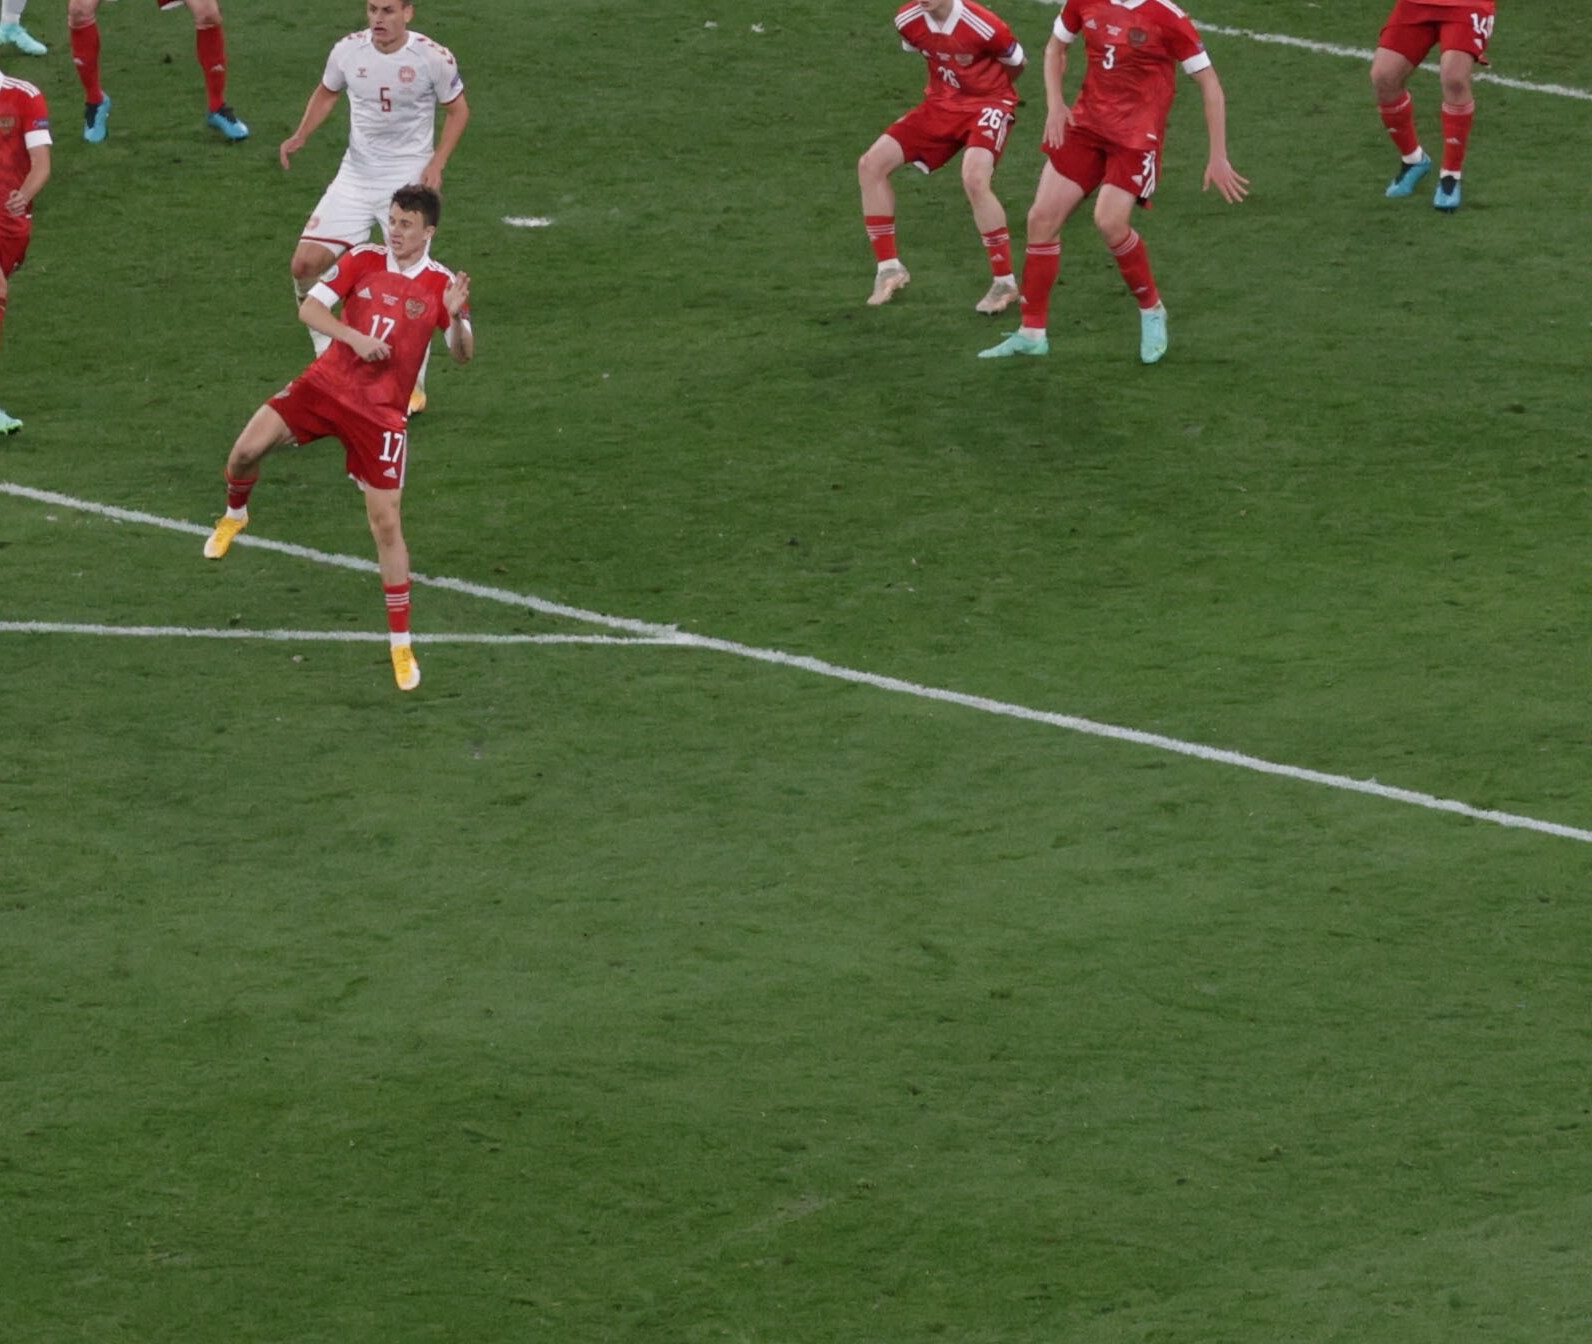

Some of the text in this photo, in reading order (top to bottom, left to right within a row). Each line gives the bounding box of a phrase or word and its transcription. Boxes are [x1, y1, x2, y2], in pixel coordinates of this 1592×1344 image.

[1102, 44, 1116, 70] 3
[379, 86, 392, 113] 5
[977, 106, 1004, 131] 26
[369, 313, 397, 344] 17
[378, 430, 405, 463] 17
